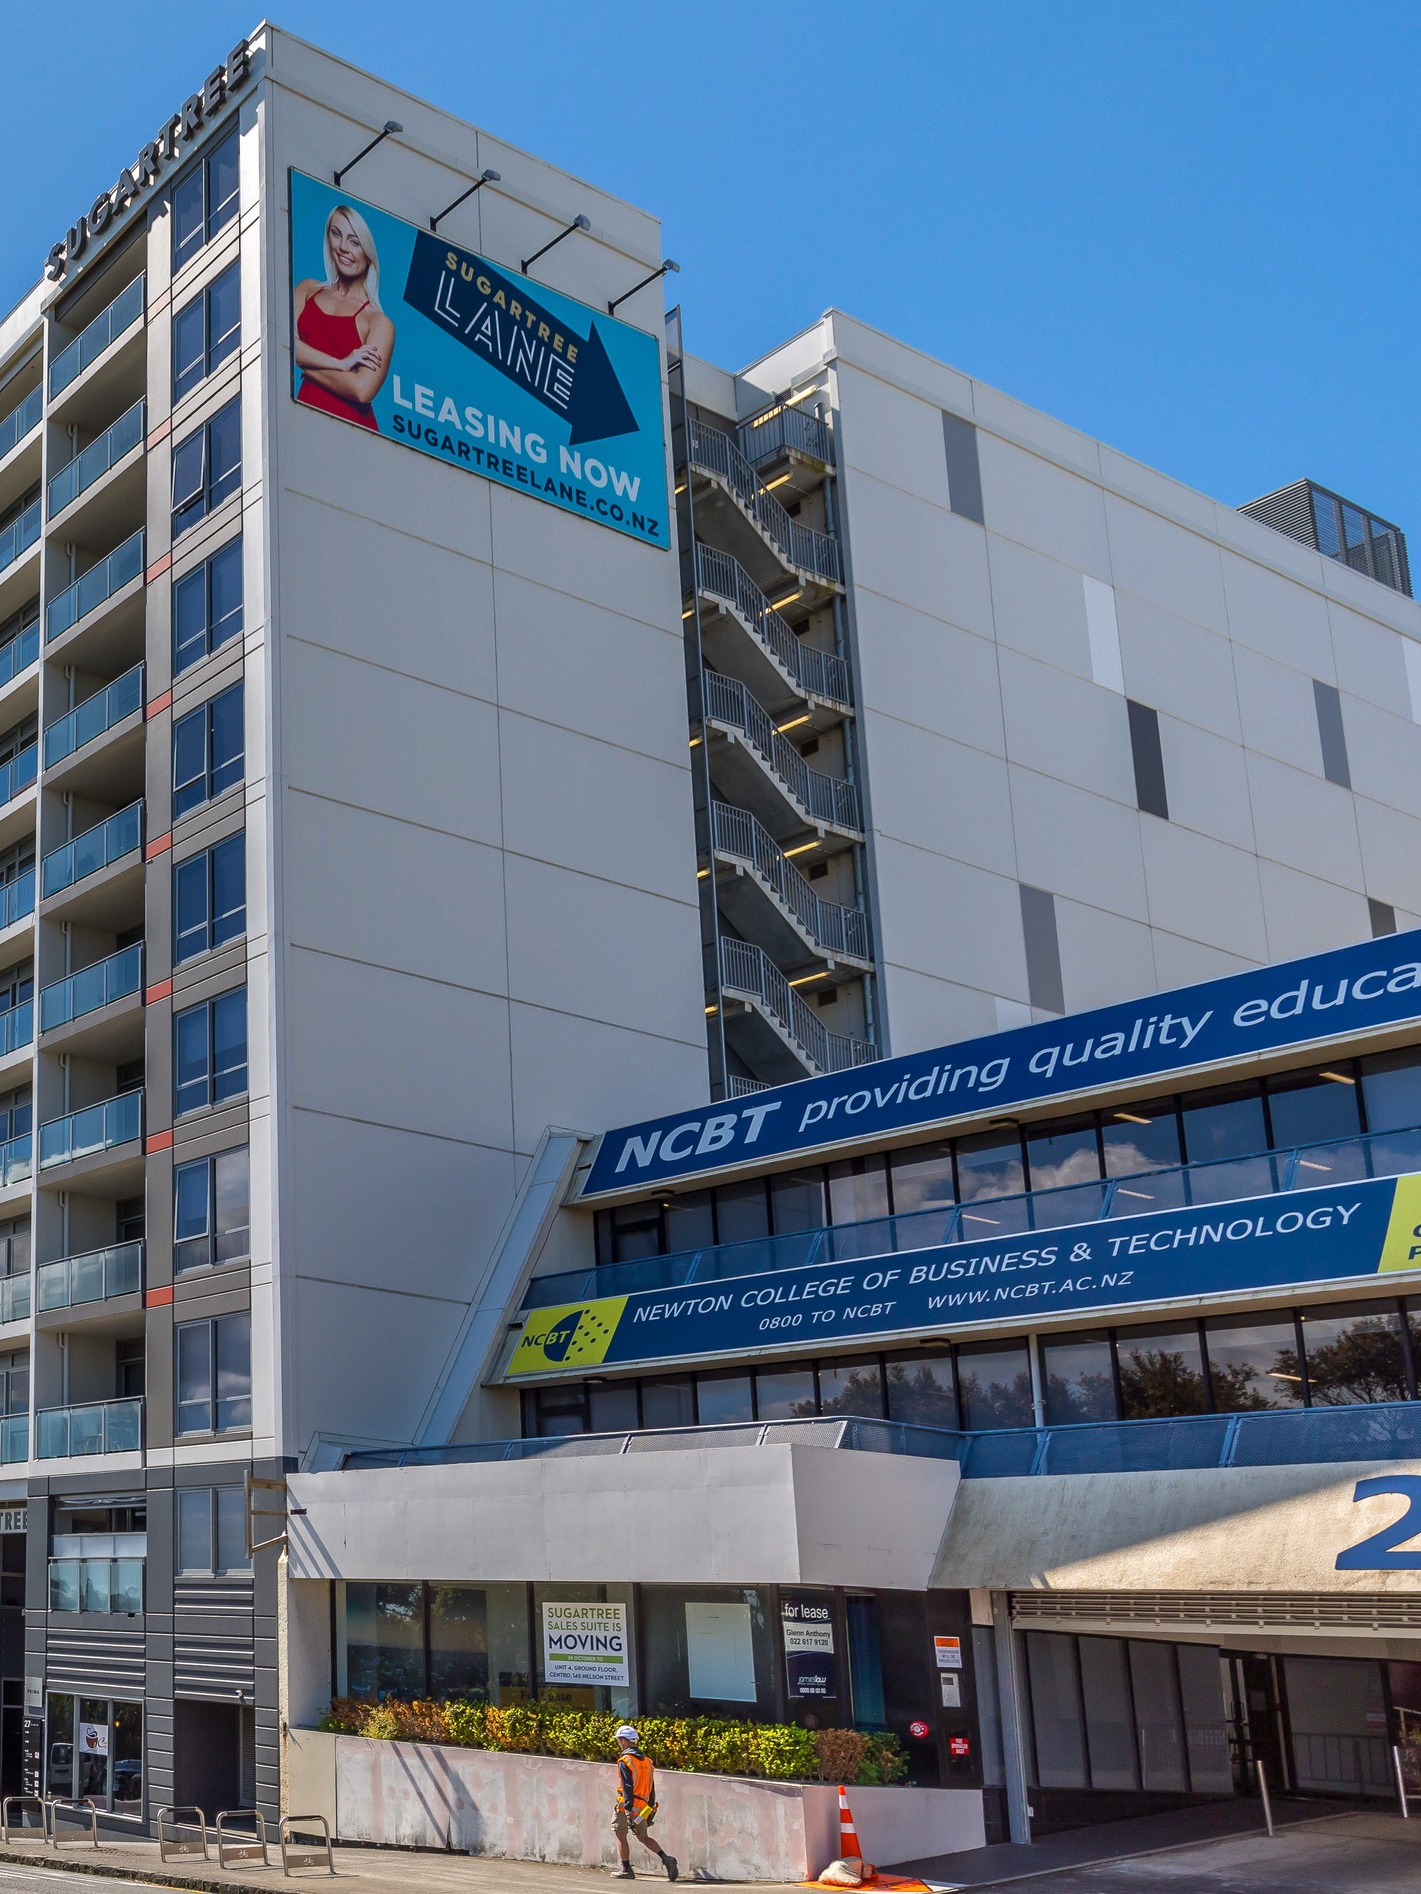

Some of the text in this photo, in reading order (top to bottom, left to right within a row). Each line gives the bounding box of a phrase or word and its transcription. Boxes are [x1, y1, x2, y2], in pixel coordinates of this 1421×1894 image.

[47, 38, 250, 282] SUGARTREE
[445, 251, 578, 364] SUGARTREE
[434, 269, 575, 410] LANE
[392, 374, 641, 503] LEASING NOW
[392, 413, 660, 538] SUGARTREELANE.CO.NZ
[614, 1101, 782, 1173] NCBT
[798, 1057, 1011, 1133] providing
[1029, 1010, 1213, 1078] quality
[633, 1202, 1361, 1323] NEWTON COLLEGE OF BUSINESS & TECHNOLOGY
[928, 1271, 1134, 1309] WWW.NCBT.AC.NZ
[759, 1302, 896, 1331] 0800 TO NCBT
[521, 1329, 571, 1348] NCBT
[1334, 1474, 1421, 1571] 2
[548, 1607, 621, 1620] SUGARTREE
[548, 1620, 622, 1632] SALES SUITE IS
[784, 1603, 829, 1619] for lease
[548, 1634, 623, 1652] MOVING
[786, 1628, 831, 1639] Glenn Anthony
[789, 1637, 829, 1646] 022 617 9120
